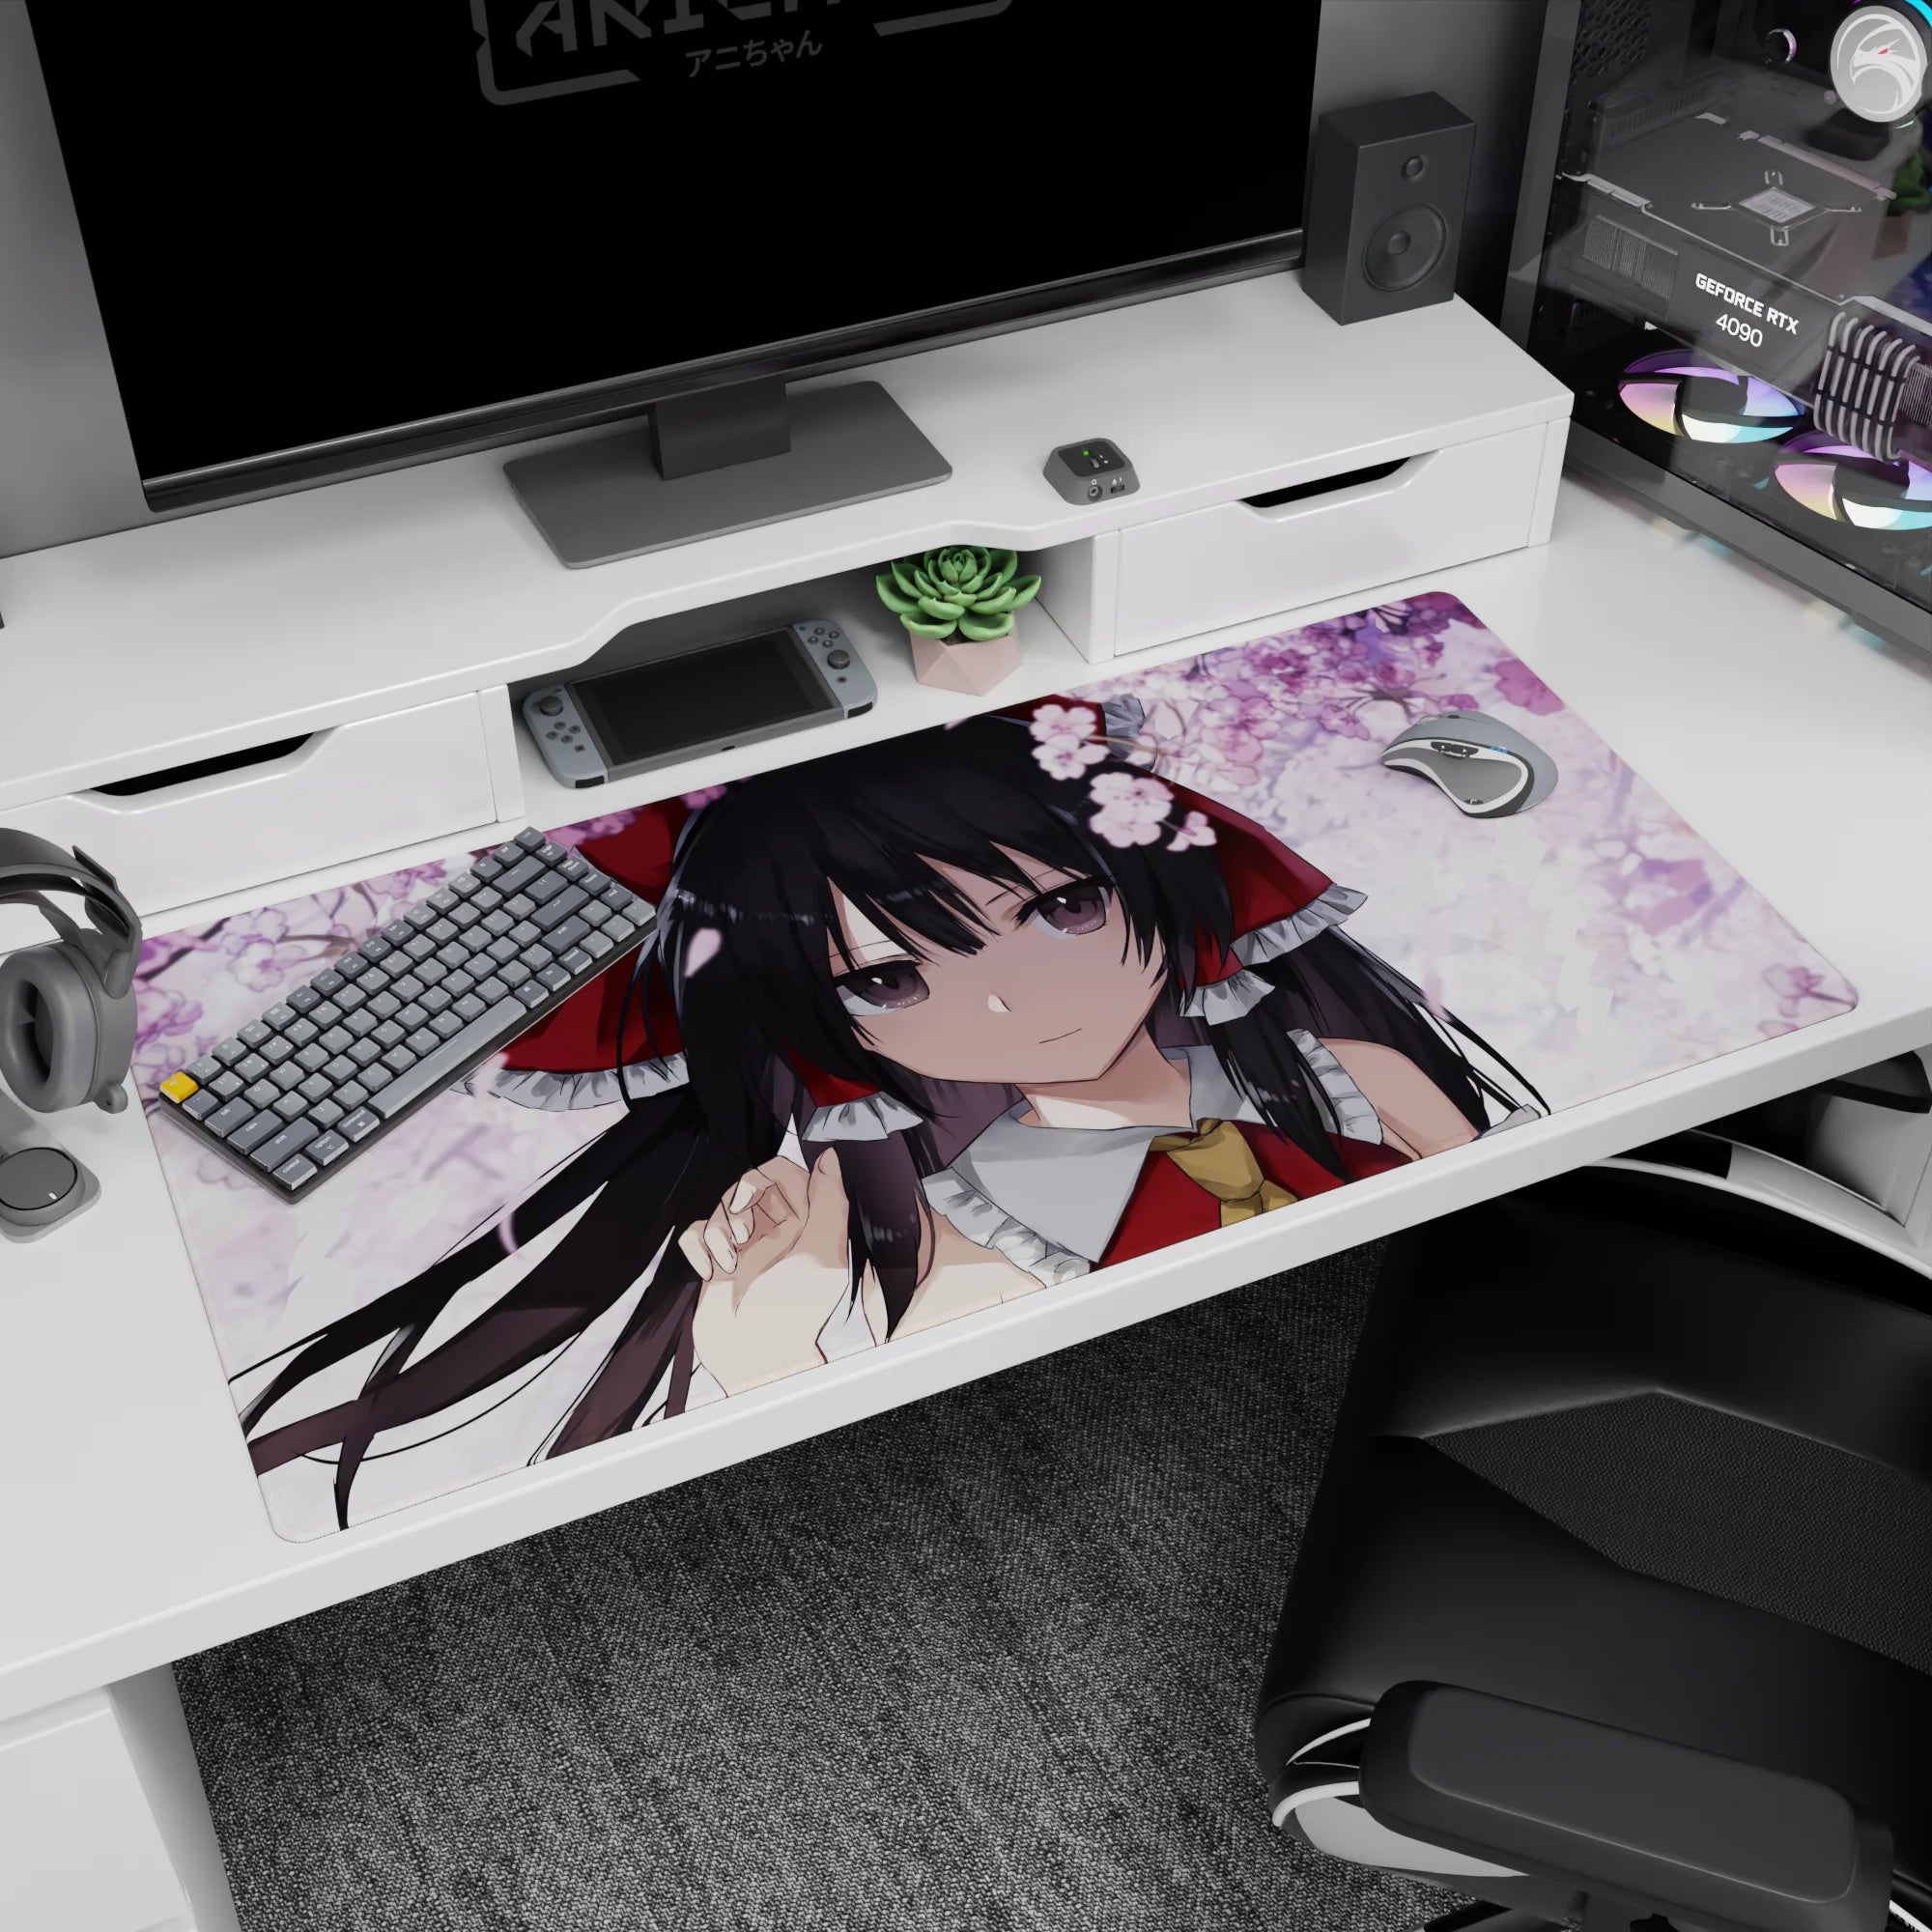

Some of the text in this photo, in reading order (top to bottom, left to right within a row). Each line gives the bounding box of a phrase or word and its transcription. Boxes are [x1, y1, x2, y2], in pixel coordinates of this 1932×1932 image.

[685, 29, 823, 78] アニちゃん
[1695, 272, 1800, 335] GEFORCE RTX
[1716, 313, 1764, 348] 4090
[342, 1109, 366, 1128] command
[315, 1136, 331, 1149] option
[282, 1158, 300, 1174] control
